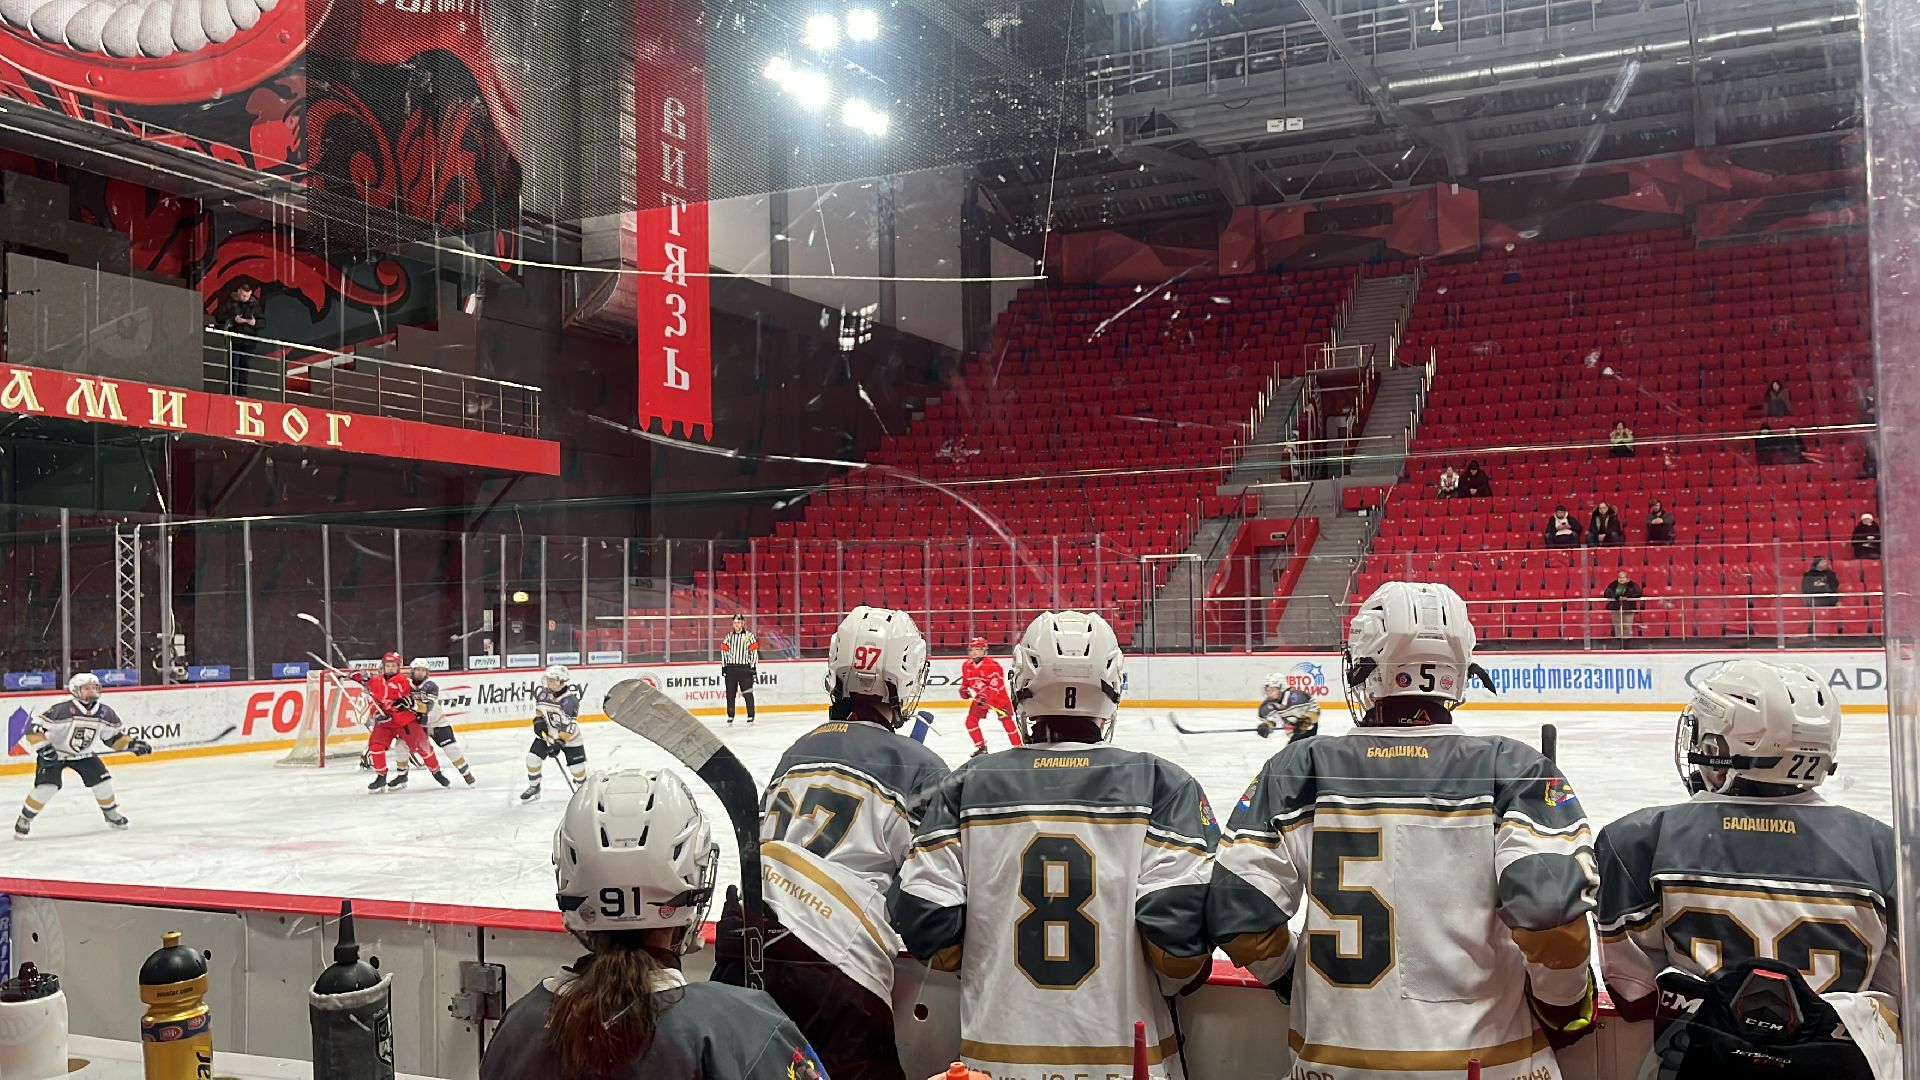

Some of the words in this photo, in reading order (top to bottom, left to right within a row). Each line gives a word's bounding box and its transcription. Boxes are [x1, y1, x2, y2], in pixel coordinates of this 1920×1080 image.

[661, 96, 690, 391] ВИТЯЗЬ
[235, 400, 352, 446] БОГ
[853, 646, 882, 671] 97
[666, 675, 720, 688] БИЛЕТЫ
[1418, 664, 1436, 692] 5
[477, 681, 588, 705] MarkHoey
[1064, 686, 1077, 709] 8
[1033, 757, 1089, 769] БАЛАШИХА
[1367, 745, 1429, 758] БАЛАШИХА
[1786, 754, 1821, 781] 22
[1723, 816, 1797, 834] БАЛАШИХА
[600, 887, 641, 917] 91
[1013, 831, 1100, 990] 8
[1307, 826, 1396, 989] 5
[1745, 1017, 1784, 1031] CCM
